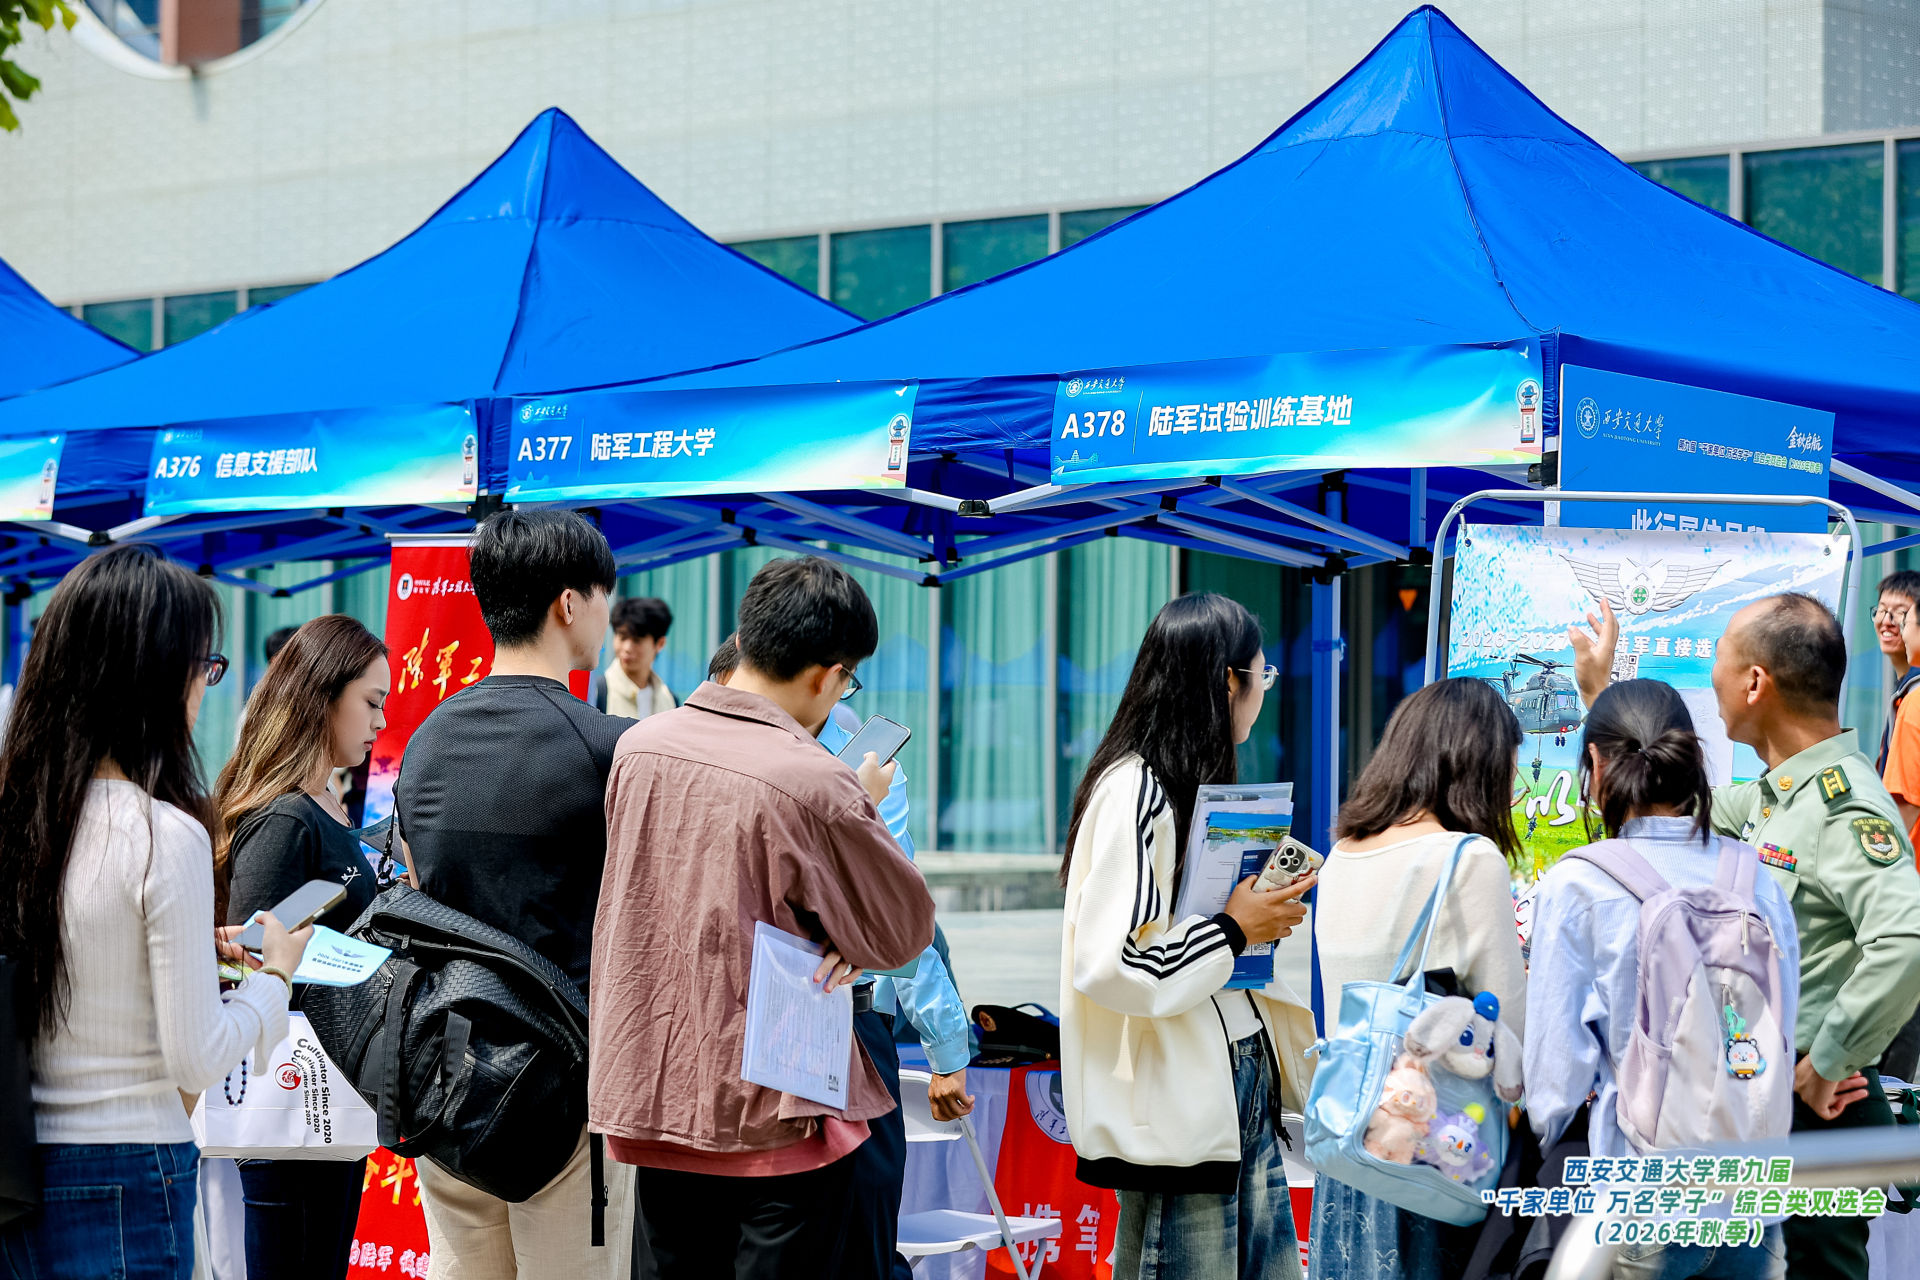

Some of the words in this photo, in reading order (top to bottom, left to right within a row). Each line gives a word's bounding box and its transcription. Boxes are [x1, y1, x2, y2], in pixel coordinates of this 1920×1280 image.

[1061, 409, 1126, 439] A378
[1148, 395, 1352, 437] 陆军试验训练基地
[517, 435, 573, 462] A377
[590, 428, 715, 461] 陆军工程大学
[155, 455, 201, 479] A376
[216, 447, 317, 479] 信息支援部队
[297, 1038, 328, 1085] Cultivator
[311, 1088, 319, 1112] Since
[321, 1086, 331, 1116] Since
[313, 1113, 321, 1134] 2020
[323, 1118, 332, 1144] 2020
